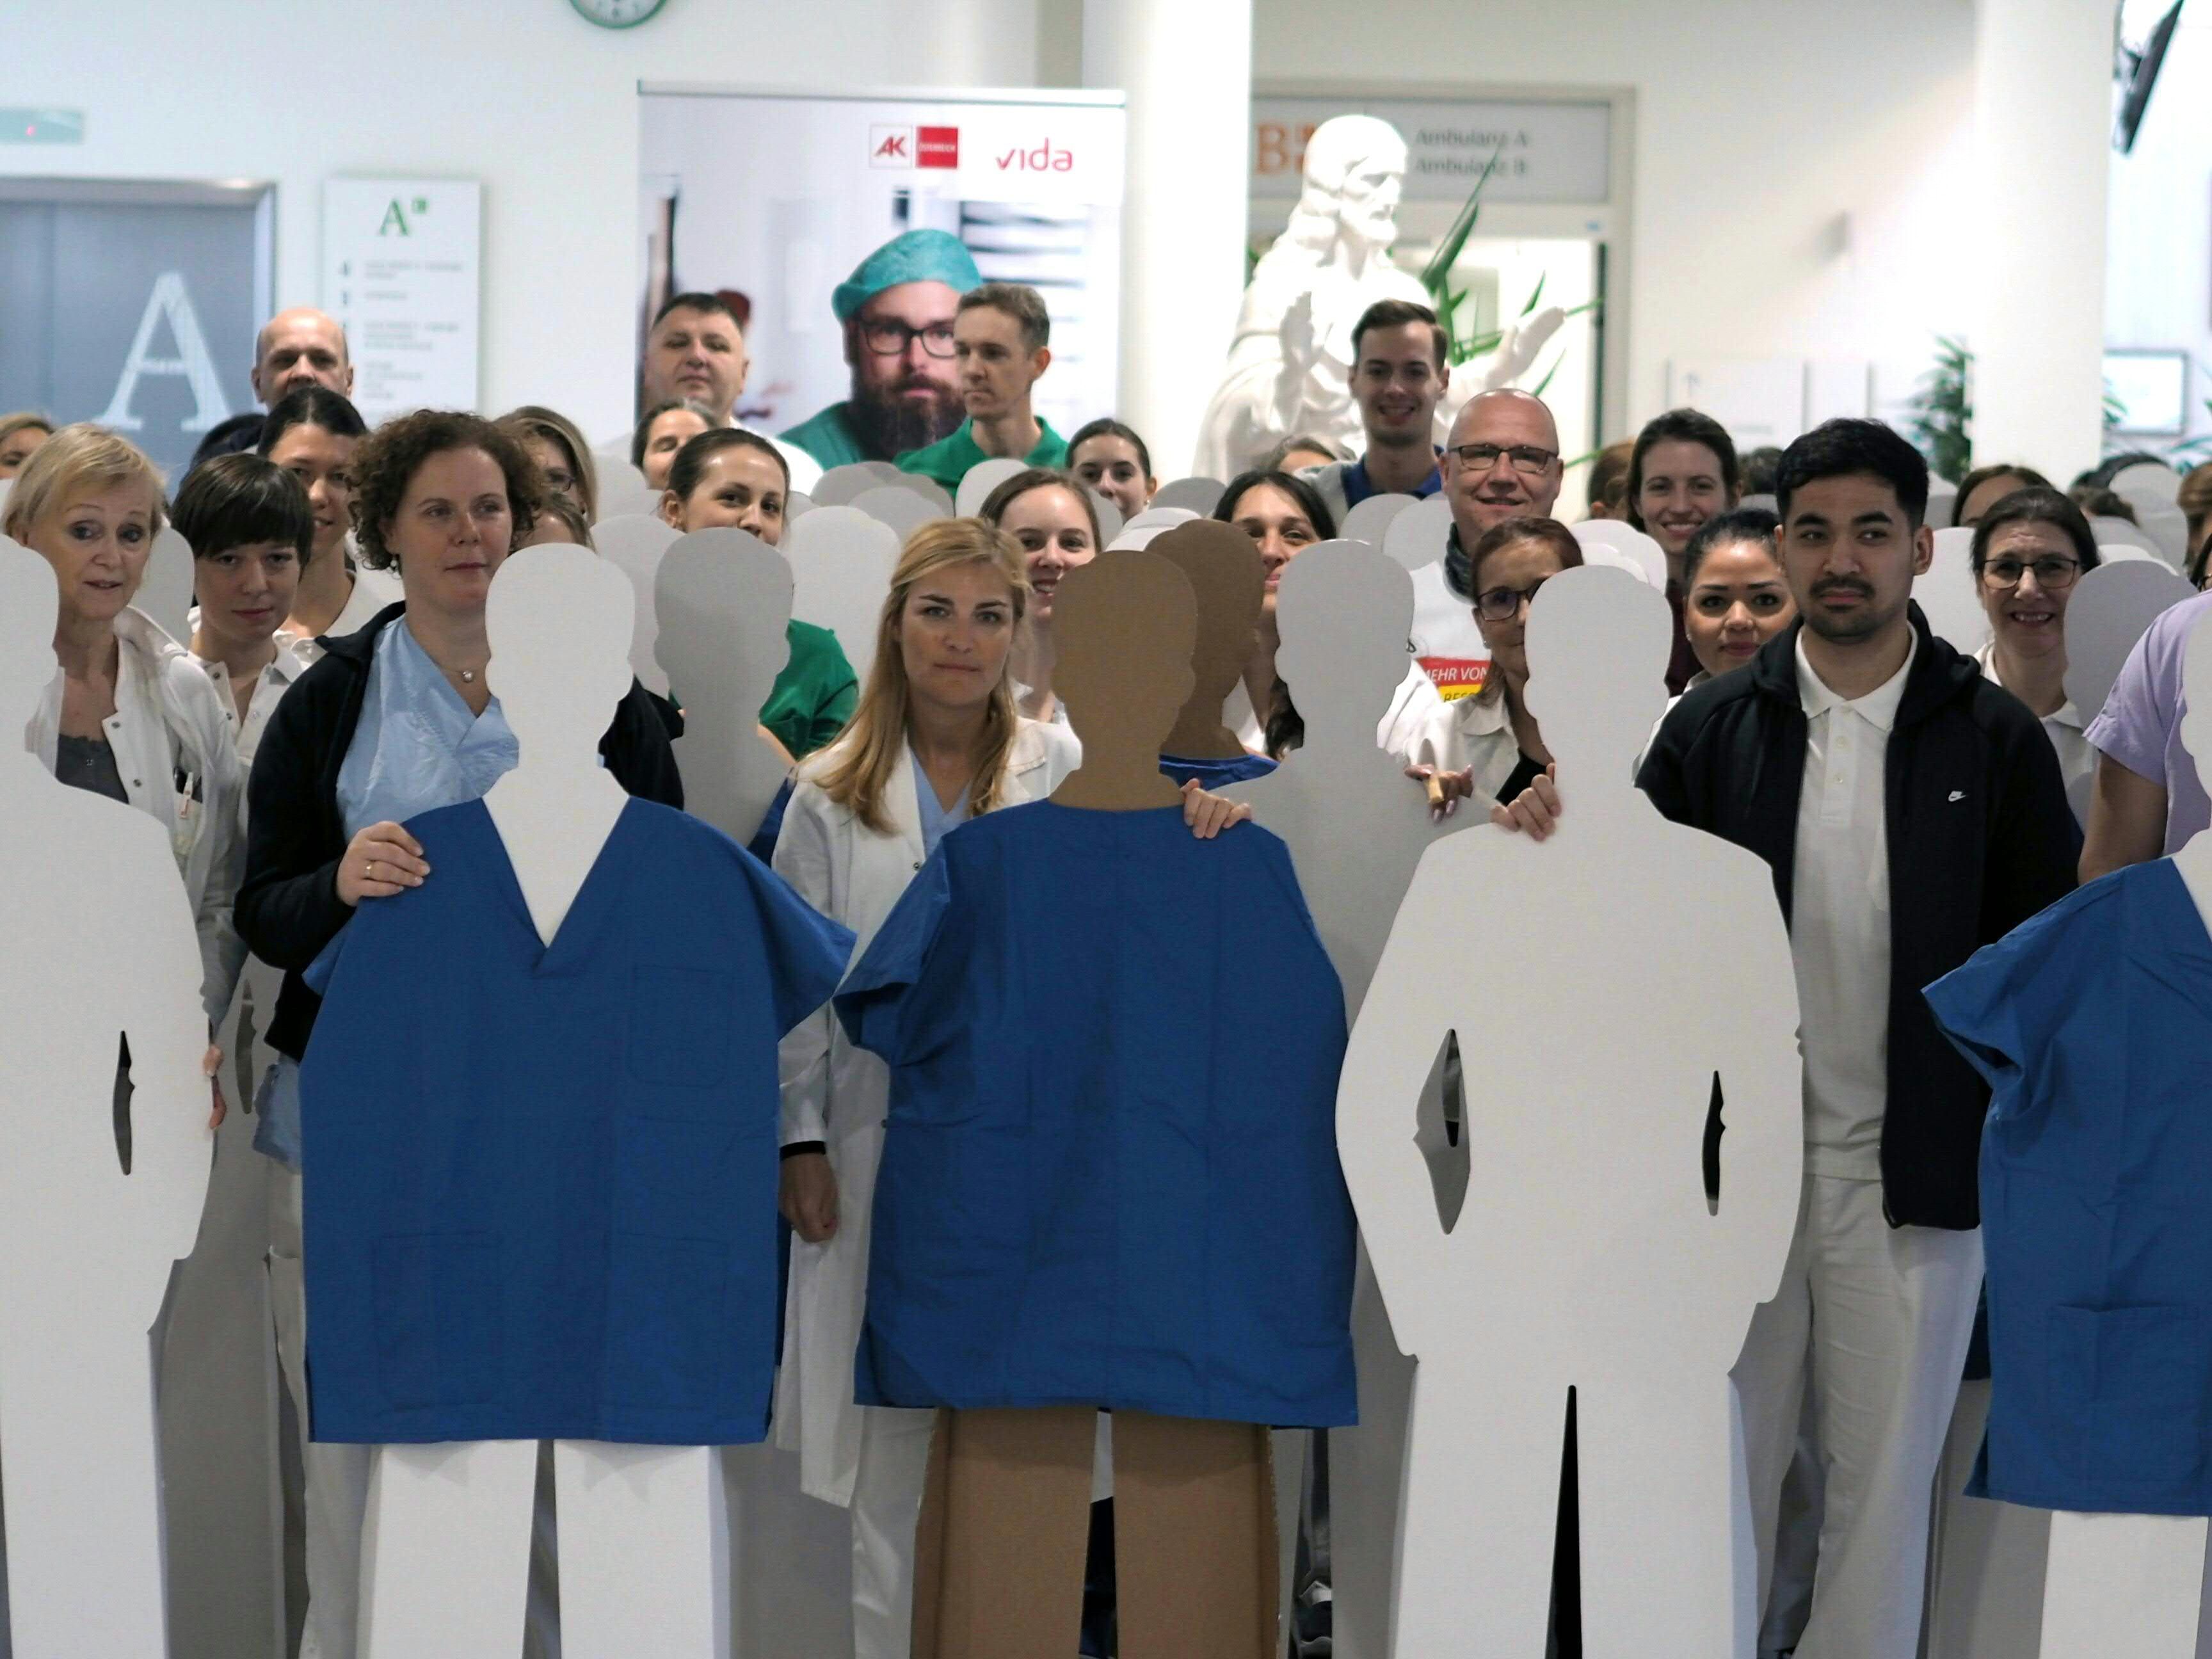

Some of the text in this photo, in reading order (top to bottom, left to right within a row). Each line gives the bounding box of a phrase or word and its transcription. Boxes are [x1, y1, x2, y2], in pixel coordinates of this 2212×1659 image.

[875, 136, 906, 157] AK
[995, 136, 1073, 172] vida
[91, 271, 234, 431] A
